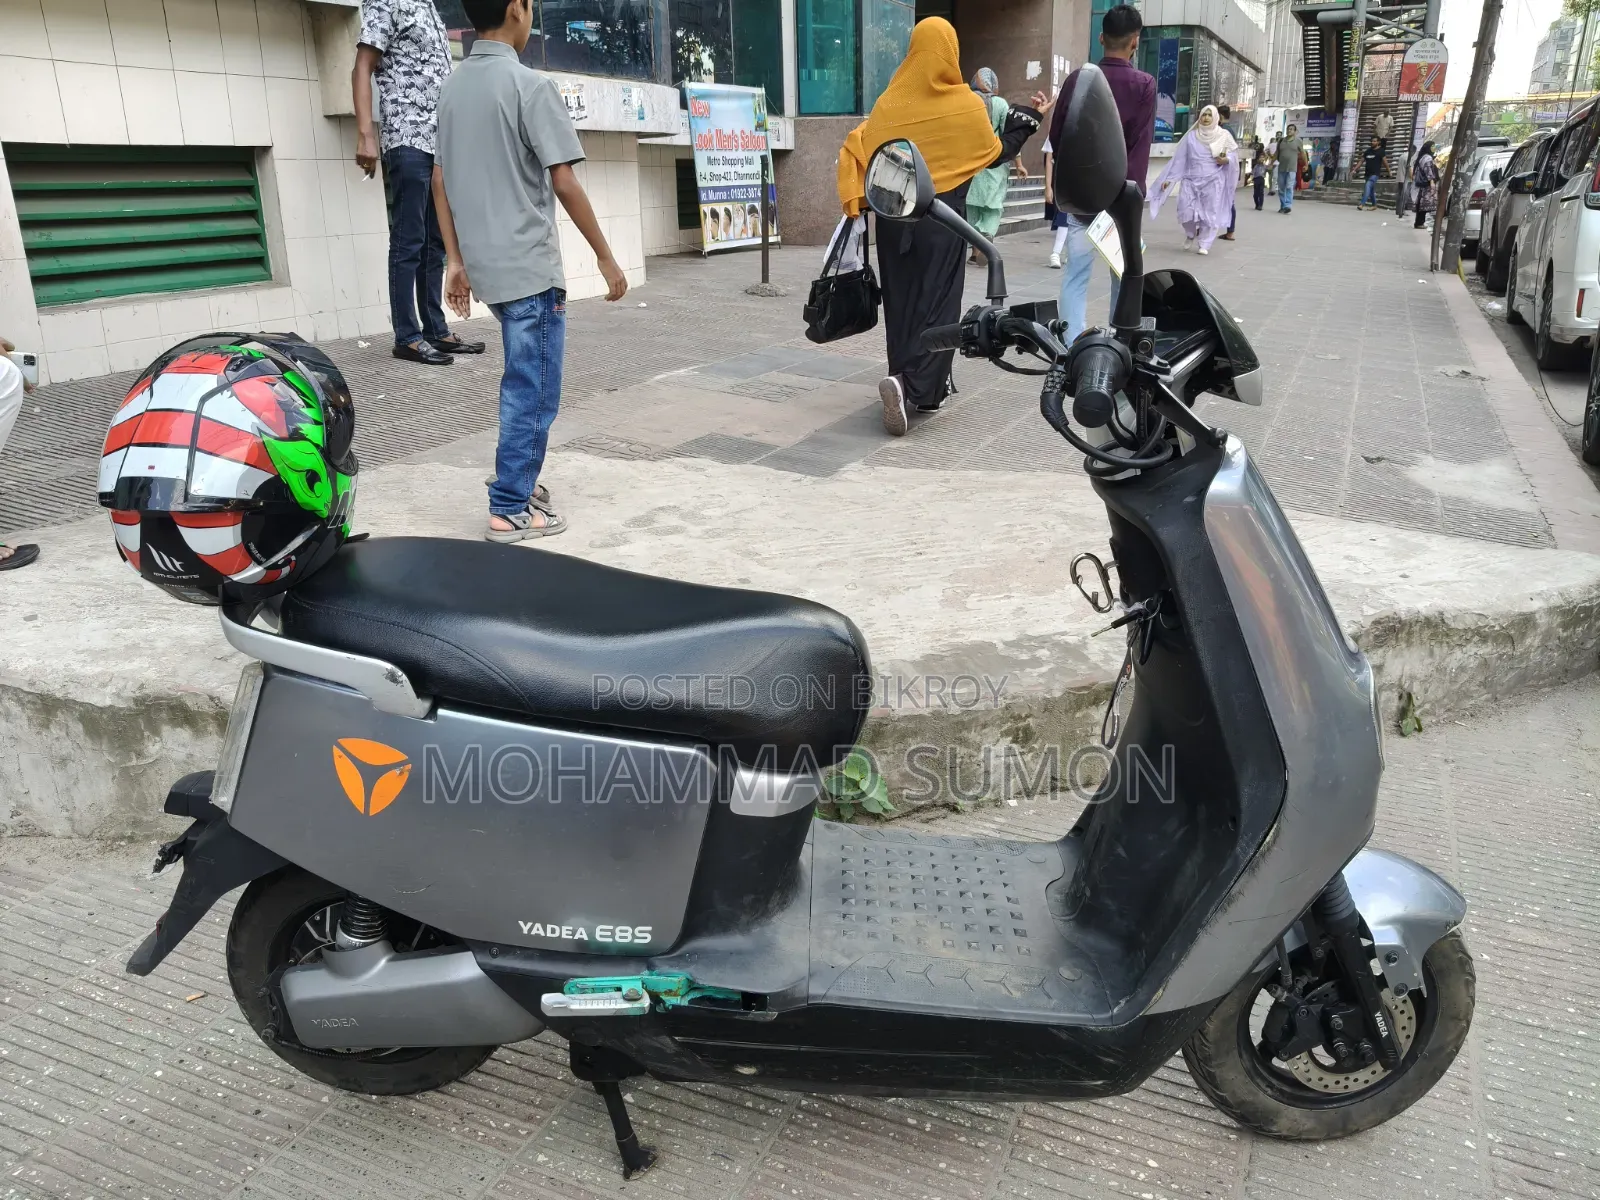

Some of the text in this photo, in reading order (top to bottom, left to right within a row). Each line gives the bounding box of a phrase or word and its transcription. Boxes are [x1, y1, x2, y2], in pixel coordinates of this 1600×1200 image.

[691, 96, 710, 117] New
[1398, 93, 1441, 102] ANWAR ISPAT
[715, 127, 739, 151] Men's
[740, 129, 767, 151] Saloon
[722, 155, 744, 168] Shopping
[518, 920, 652, 943] YADEA E8S
[311, 1017, 359, 1028] YADEA
[1374, 1011, 1388, 1038] YADEA
